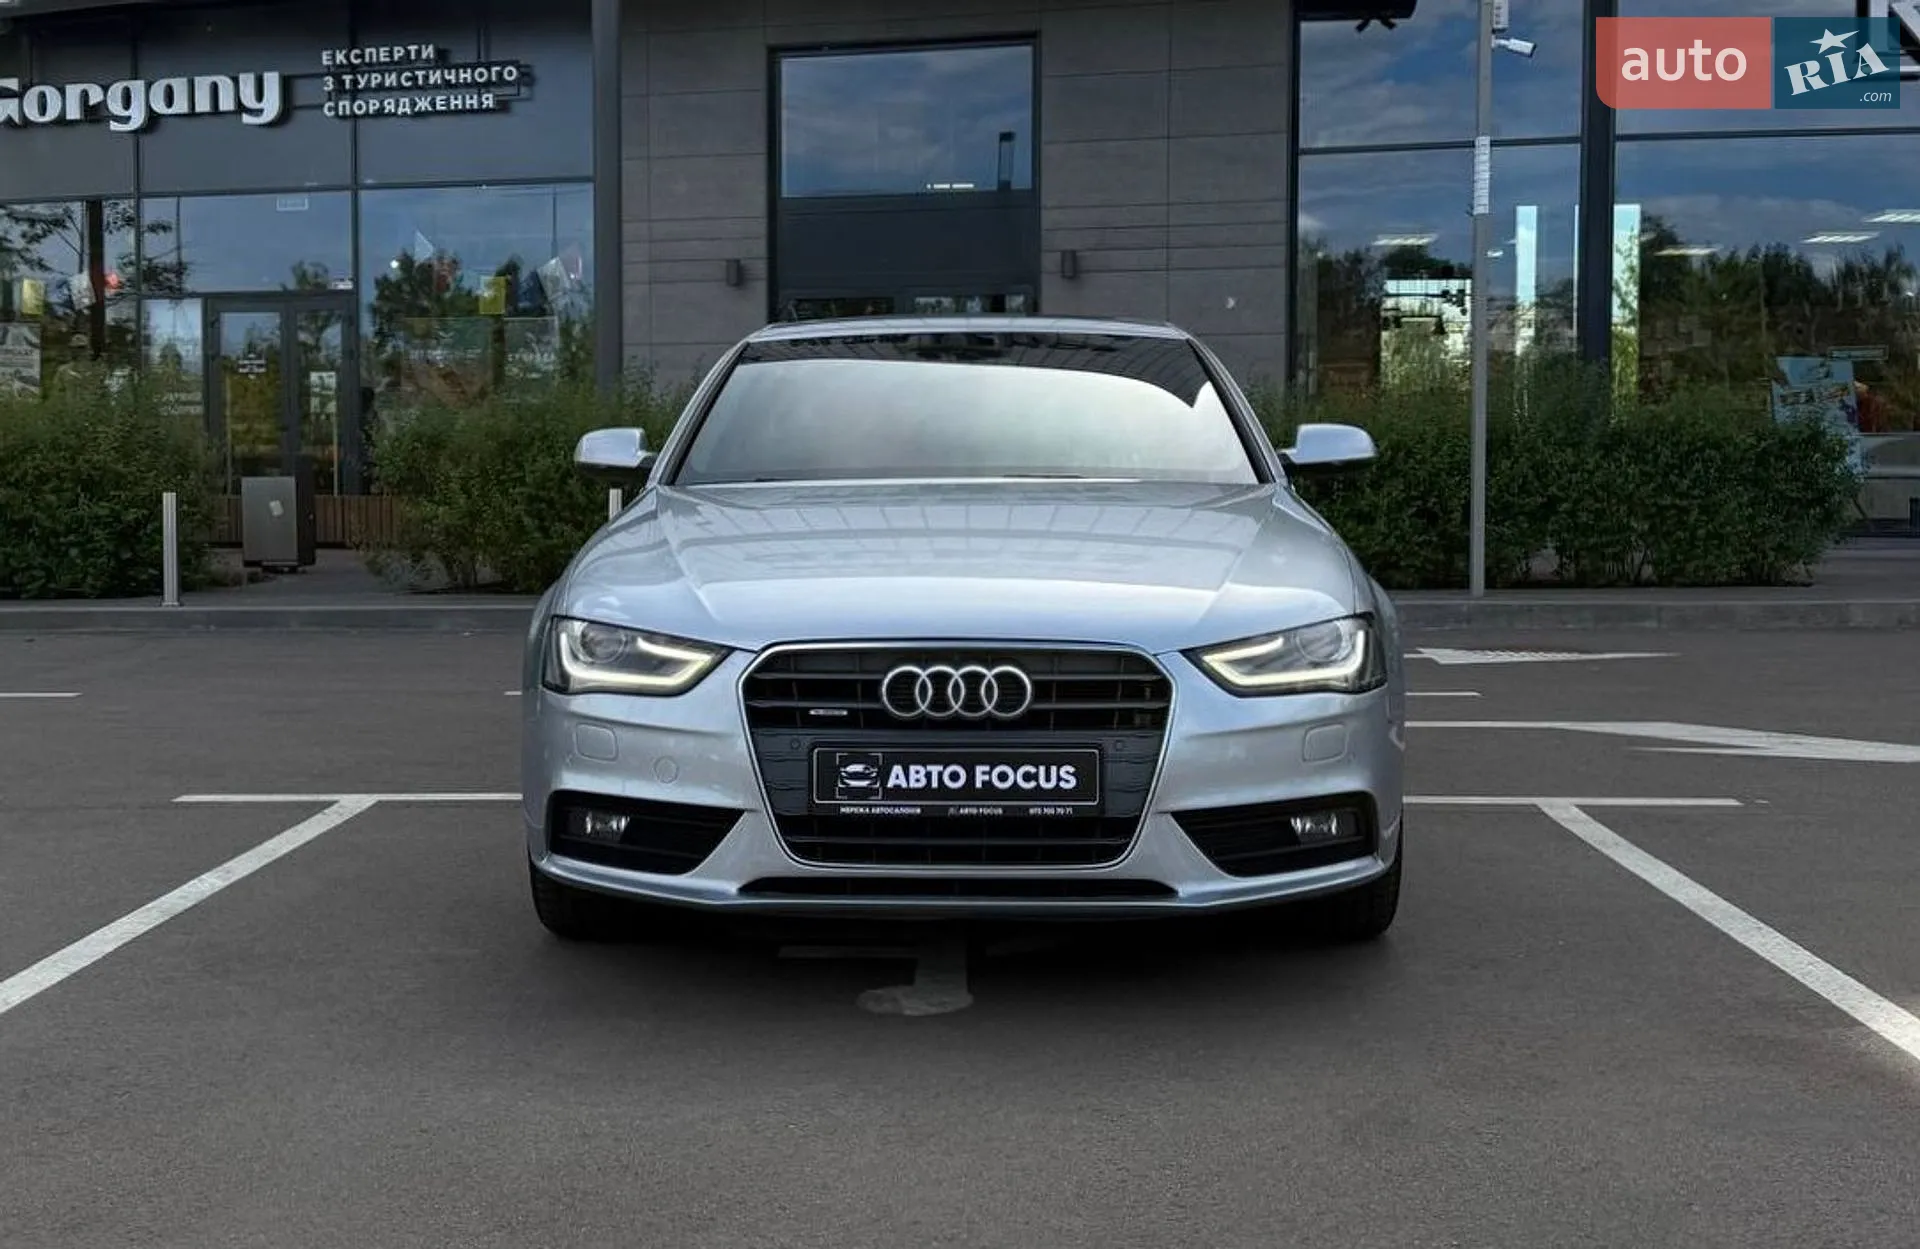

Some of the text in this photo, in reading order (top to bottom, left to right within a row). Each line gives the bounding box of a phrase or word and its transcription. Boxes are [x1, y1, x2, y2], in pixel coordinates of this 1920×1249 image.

[321, 44, 435, 65] ЕКСПЕРТИ
[342, 65, 518, 90] ТУРИСТИЧНОГО
[323, 93, 495, 116] СПОРЯДЖЕННЯ
[886, 764, 1077, 790] АВТО FOCUS
